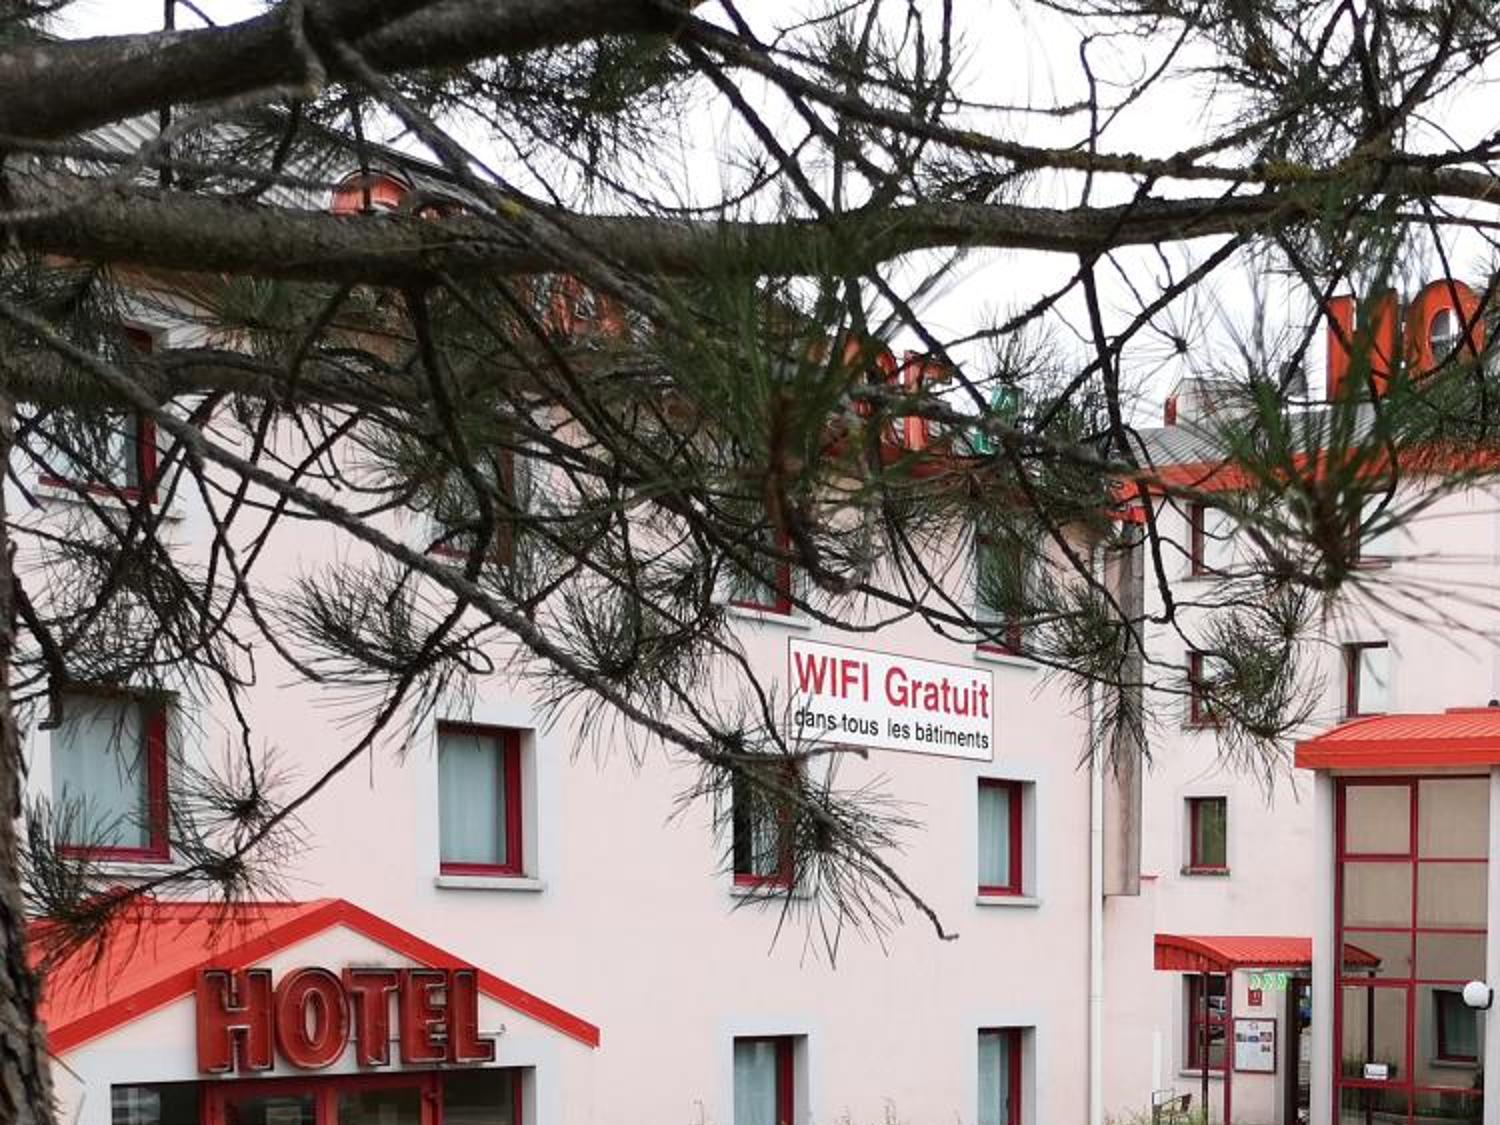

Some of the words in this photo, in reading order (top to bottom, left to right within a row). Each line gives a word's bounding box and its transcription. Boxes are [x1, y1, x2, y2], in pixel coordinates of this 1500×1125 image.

[794, 651, 869, 702] WIFI
[884, 666, 990, 719] Gratuit
[795, 707, 838, 731] dans
[842, 714, 879, 737] tous
[887, 718, 911, 740] les
[915, 723, 989, 749] bâtiments
[196, 967, 496, 1076] HOTEL
